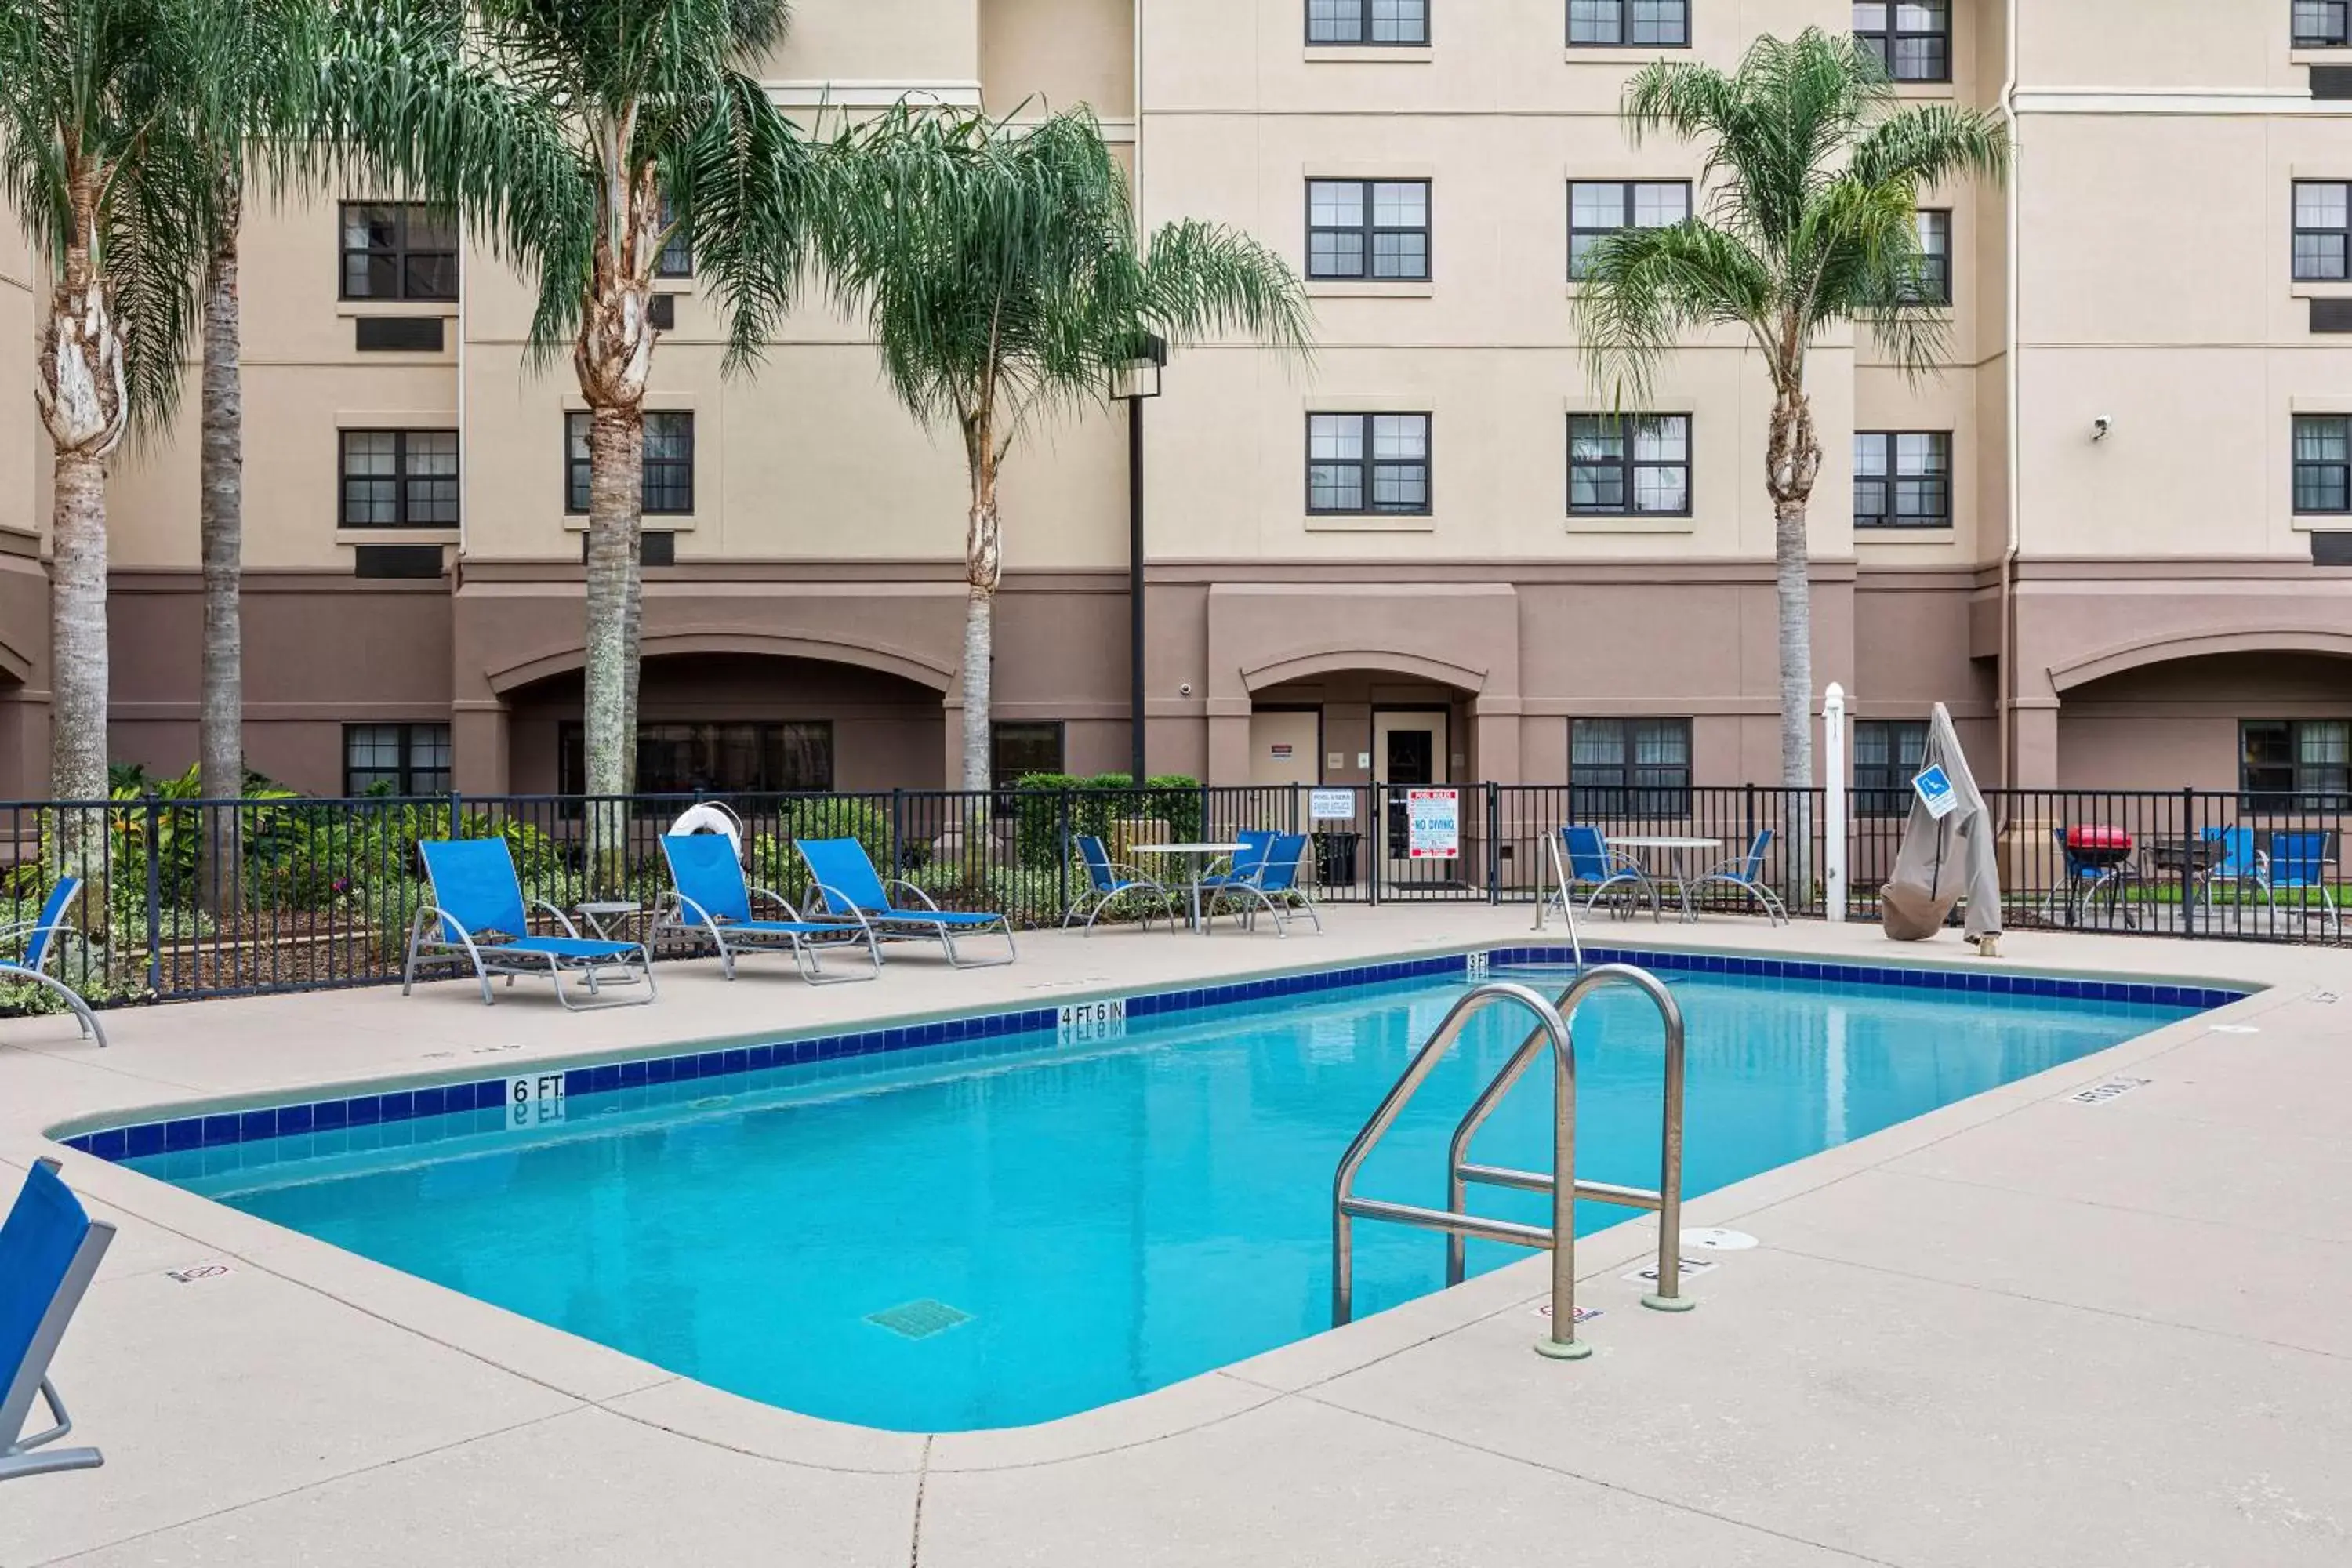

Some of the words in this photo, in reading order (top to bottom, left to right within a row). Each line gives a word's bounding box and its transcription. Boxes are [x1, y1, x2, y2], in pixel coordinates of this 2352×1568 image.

[1415, 818, 1425, 830] NO
[1428, 818, 1454, 830] DIVING
[1470, 954, 1477, 968] 3
[1062, 1007, 1071, 1025] 4
[1097, 1003, 1105, 1020] 6
[514, 1080, 528, 1102] 6
